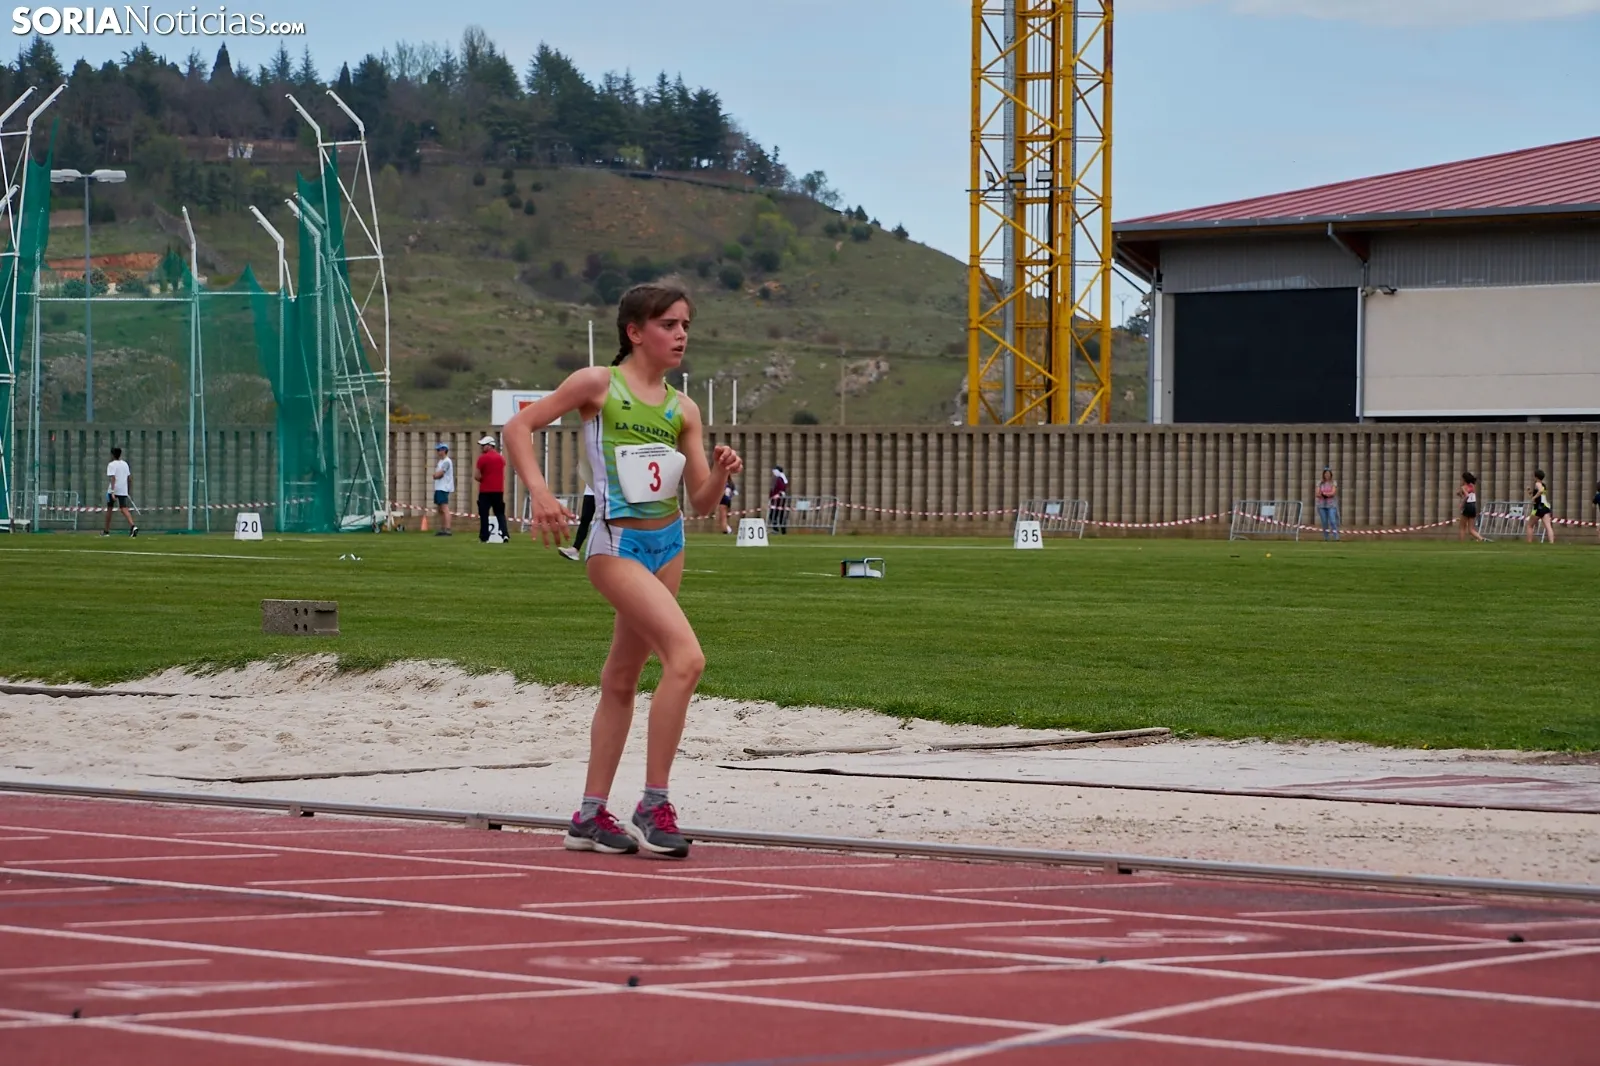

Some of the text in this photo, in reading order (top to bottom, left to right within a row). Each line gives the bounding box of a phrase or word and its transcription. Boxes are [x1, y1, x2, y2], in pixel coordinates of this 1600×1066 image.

[615, 422, 629, 431] LA
[648, 461, 661, 492] 3
[241, 520, 258, 533] 20
[748, 526, 765, 540] 30
[1021, 529, 1039, 543] 35
